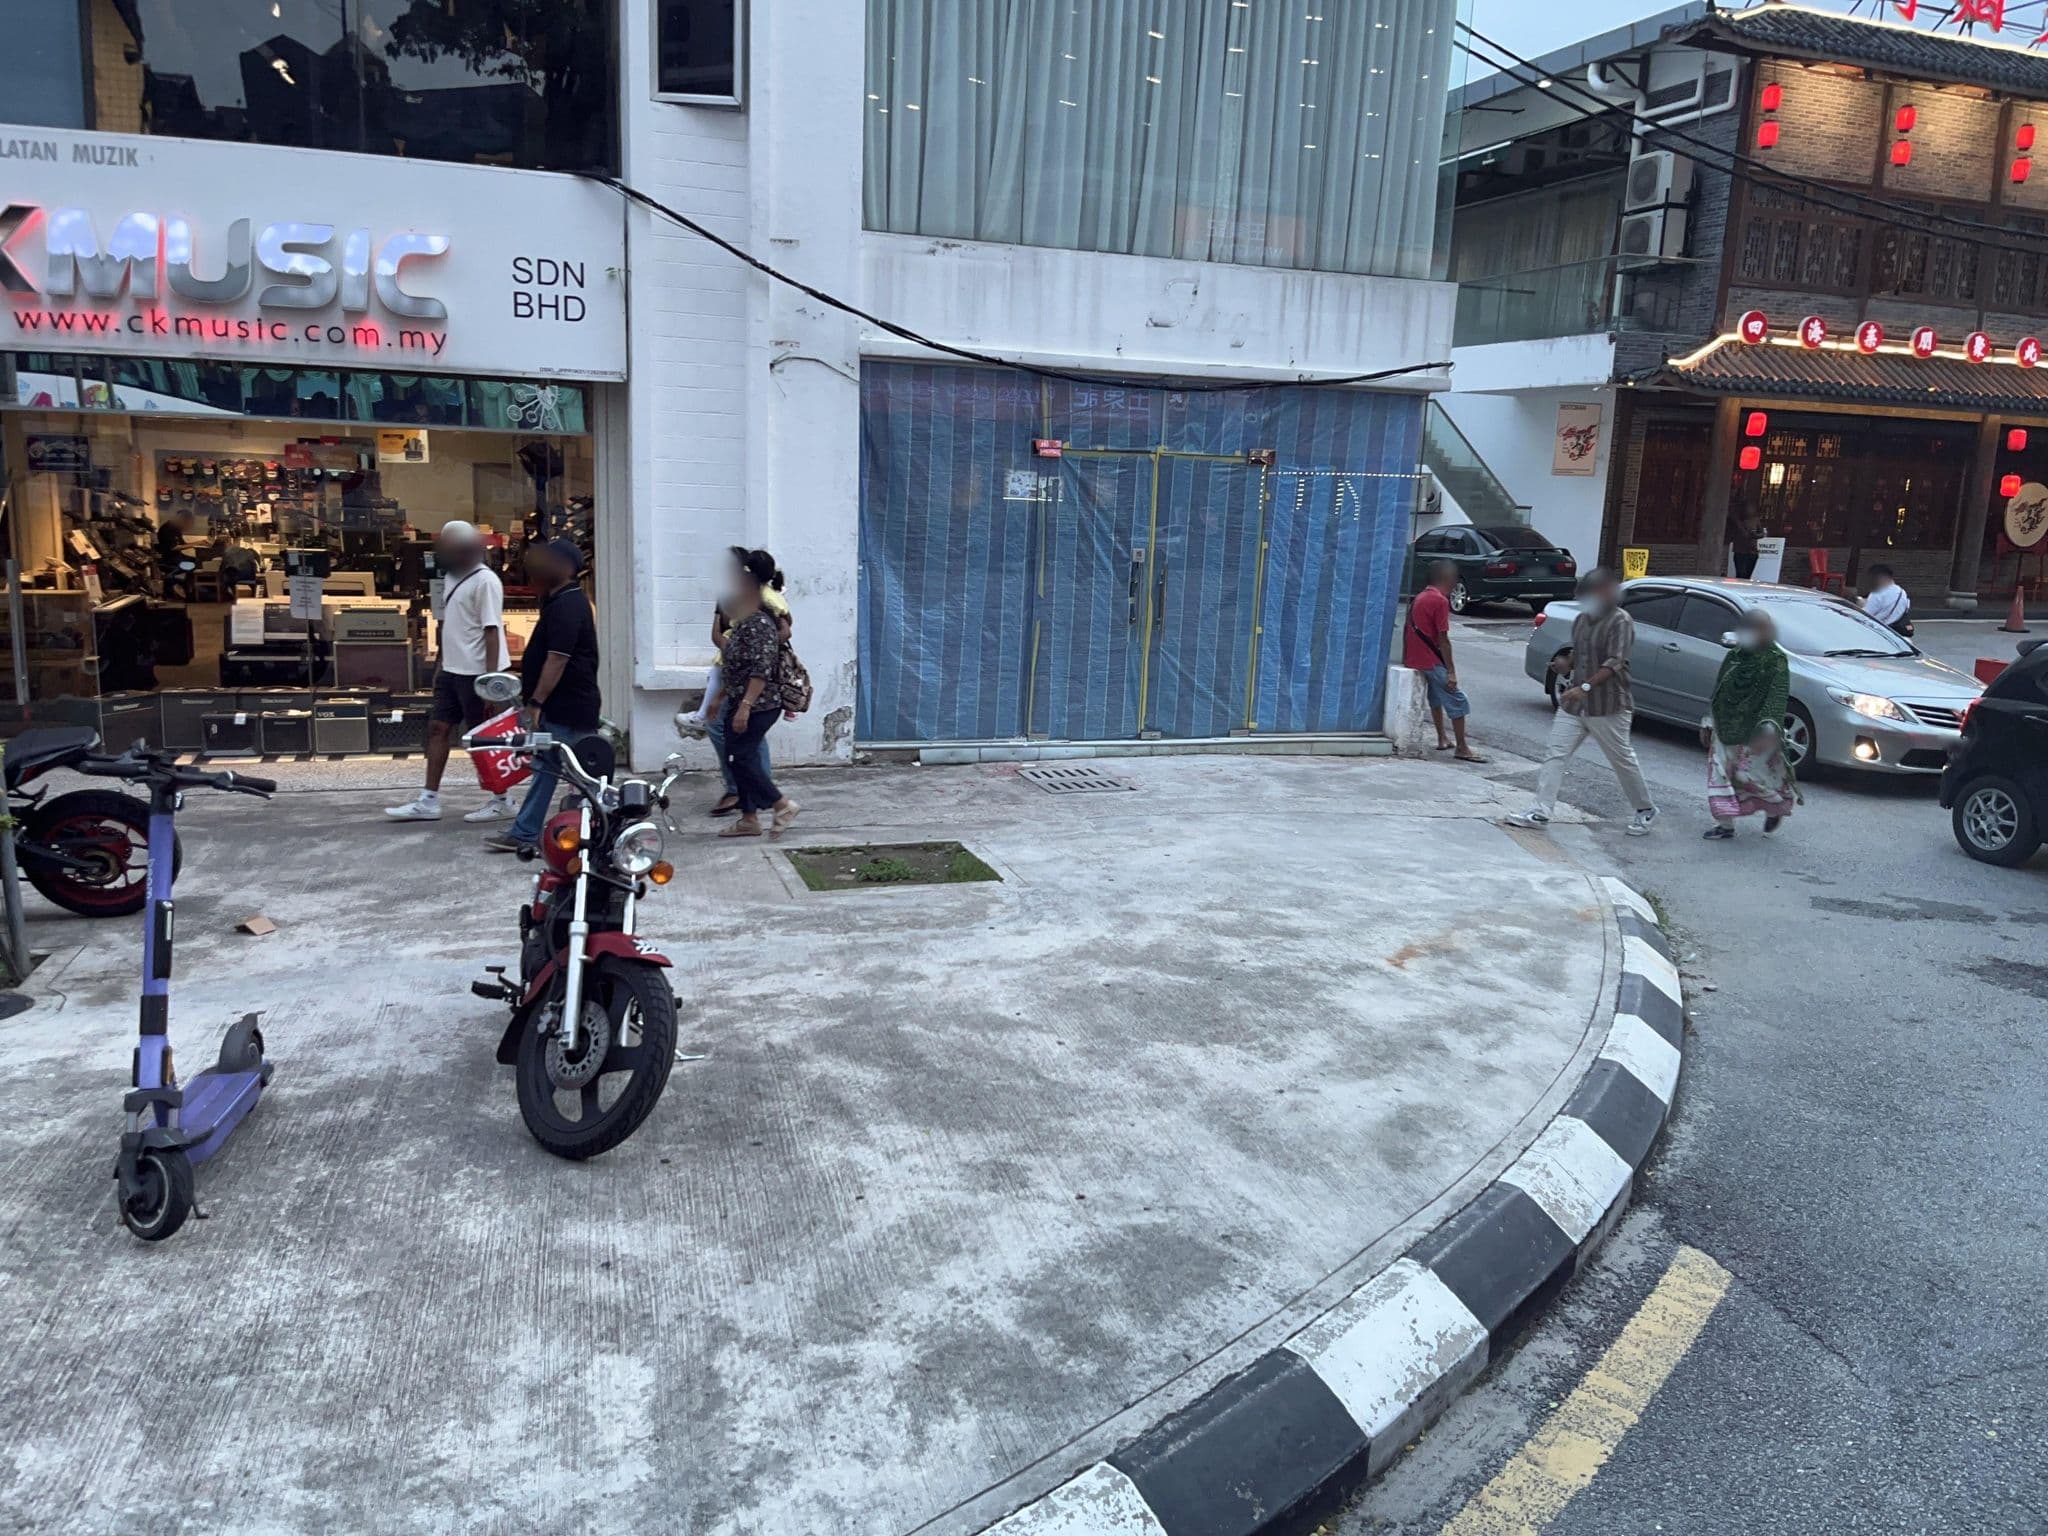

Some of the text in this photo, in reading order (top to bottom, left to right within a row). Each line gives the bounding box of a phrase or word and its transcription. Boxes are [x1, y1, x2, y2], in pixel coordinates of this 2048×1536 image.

[72, 143, 139, 167] MUZIK
[512, 256, 585, 289] SDN
[513, 291, 586, 322] BHD
[13, 309, 448, 356] www.ckmusic.com.my
